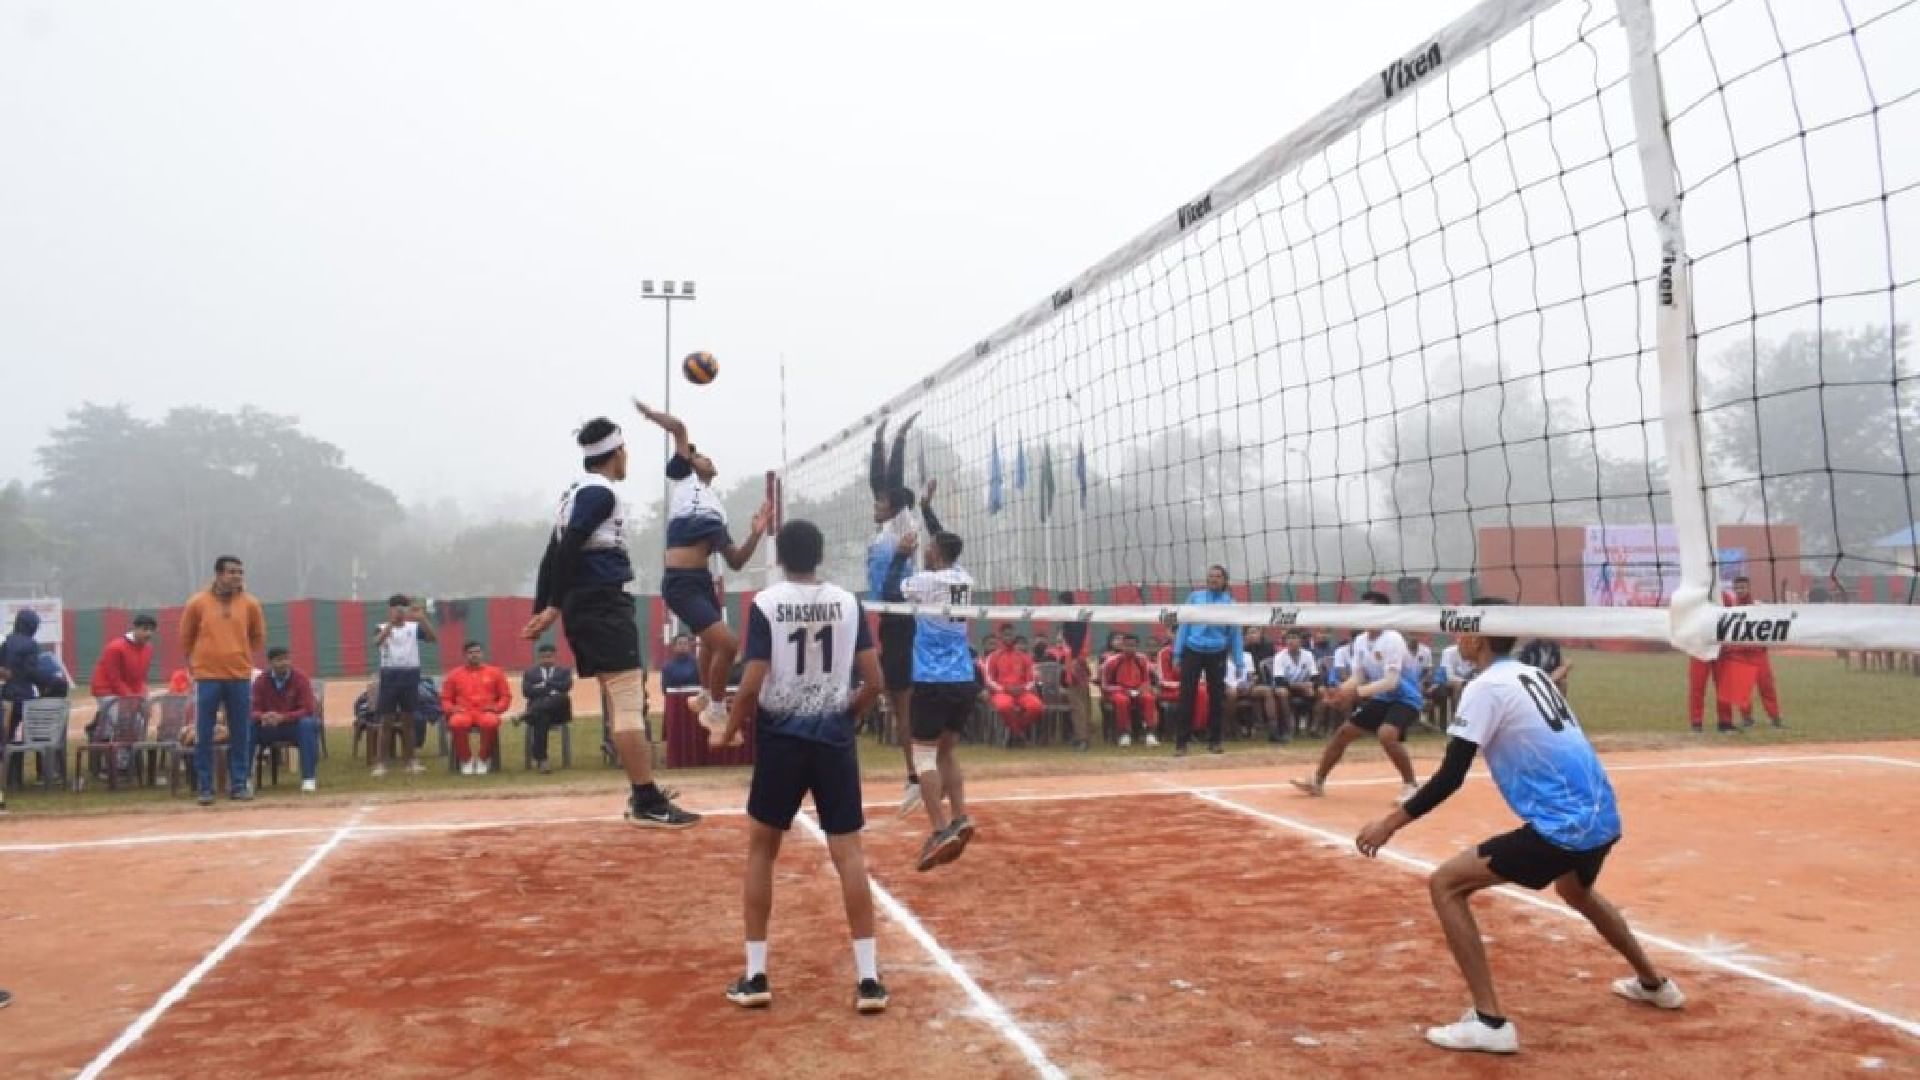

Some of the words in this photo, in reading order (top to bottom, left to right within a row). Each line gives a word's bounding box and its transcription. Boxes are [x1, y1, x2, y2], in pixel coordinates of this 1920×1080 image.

[1381, 42, 1442, 99] Vixen
[1440, 609, 1482, 633] Vixen
[1716, 611, 1791, 641] Vixen
[787, 625, 833, 676] 11
